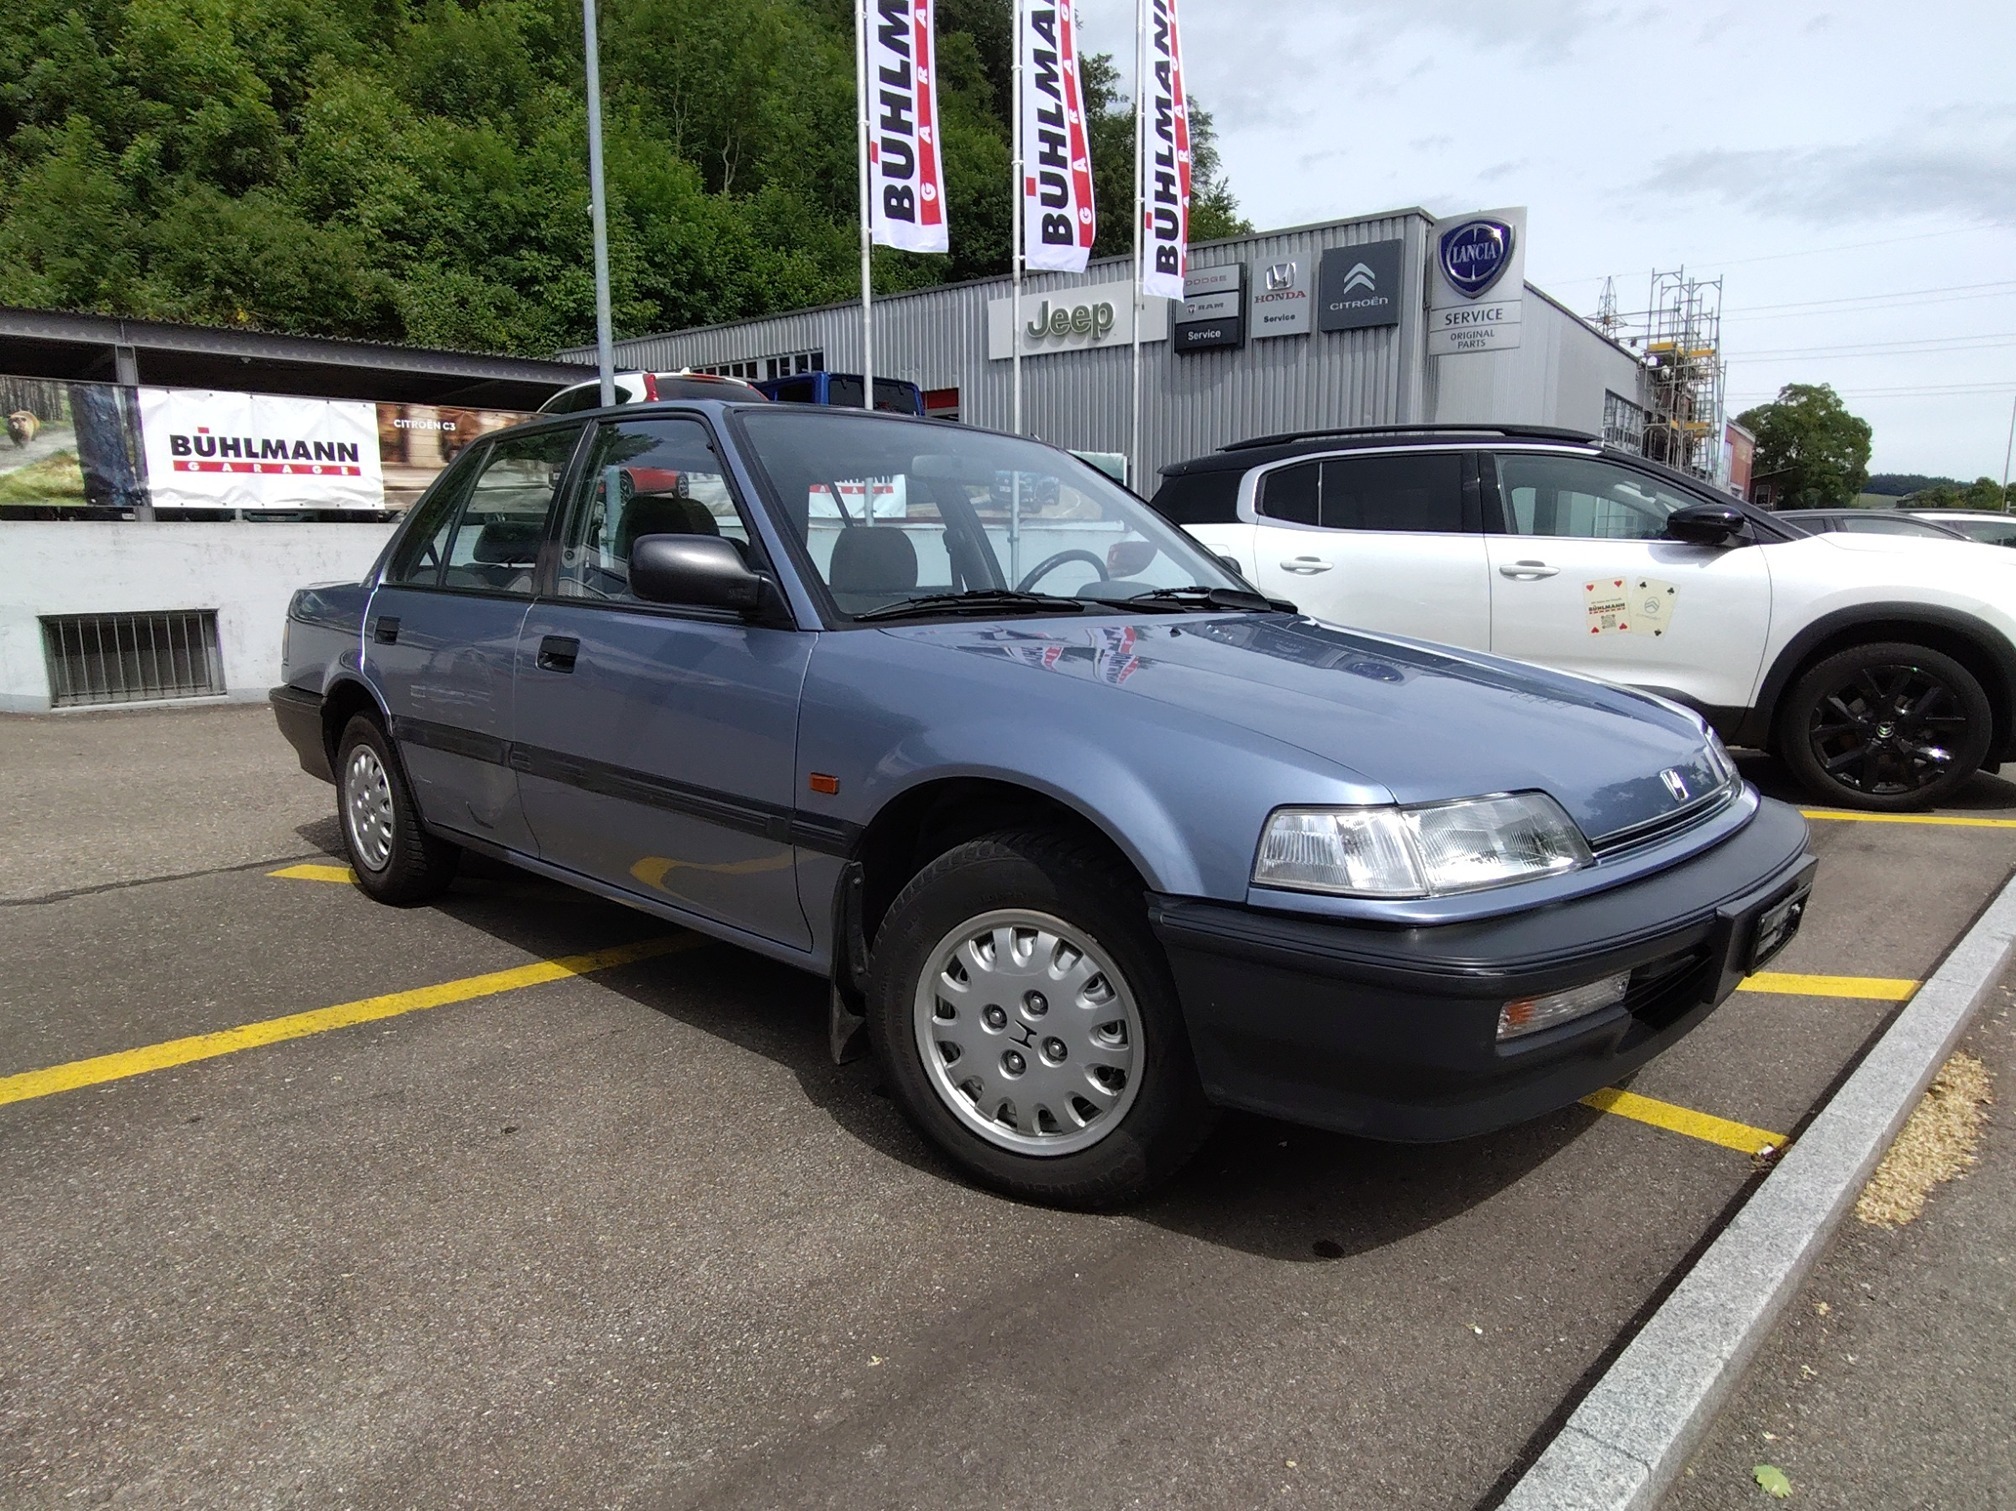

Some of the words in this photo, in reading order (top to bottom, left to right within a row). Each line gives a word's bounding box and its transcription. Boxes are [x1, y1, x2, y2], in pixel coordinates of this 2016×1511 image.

[1025, 0, 1073, 246] BÜHLMA
[1452, 241, 1498, 264] LANCIA
[1185, 275, 1228, 287] DODGE
[1254, 290, 1306, 304] HONDA
[1198, 302, 1224, 312] RAM
[1027, 300, 1115, 339] Jeep
[1263, 313, 1296, 323] Service
[1445, 308, 1504, 326] SERVICE
[1188, 329, 1221, 341] Service
[1450, 328, 1495, 341] ORIGINAL
[1457, 339, 1486, 350] PARTS
[393, 419, 441, 430] CITROËN
[442, 421, 456, 431] C3
[169, 426, 359, 463] BÜHLMANN
[187, 461, 350, 476] GARAGE
